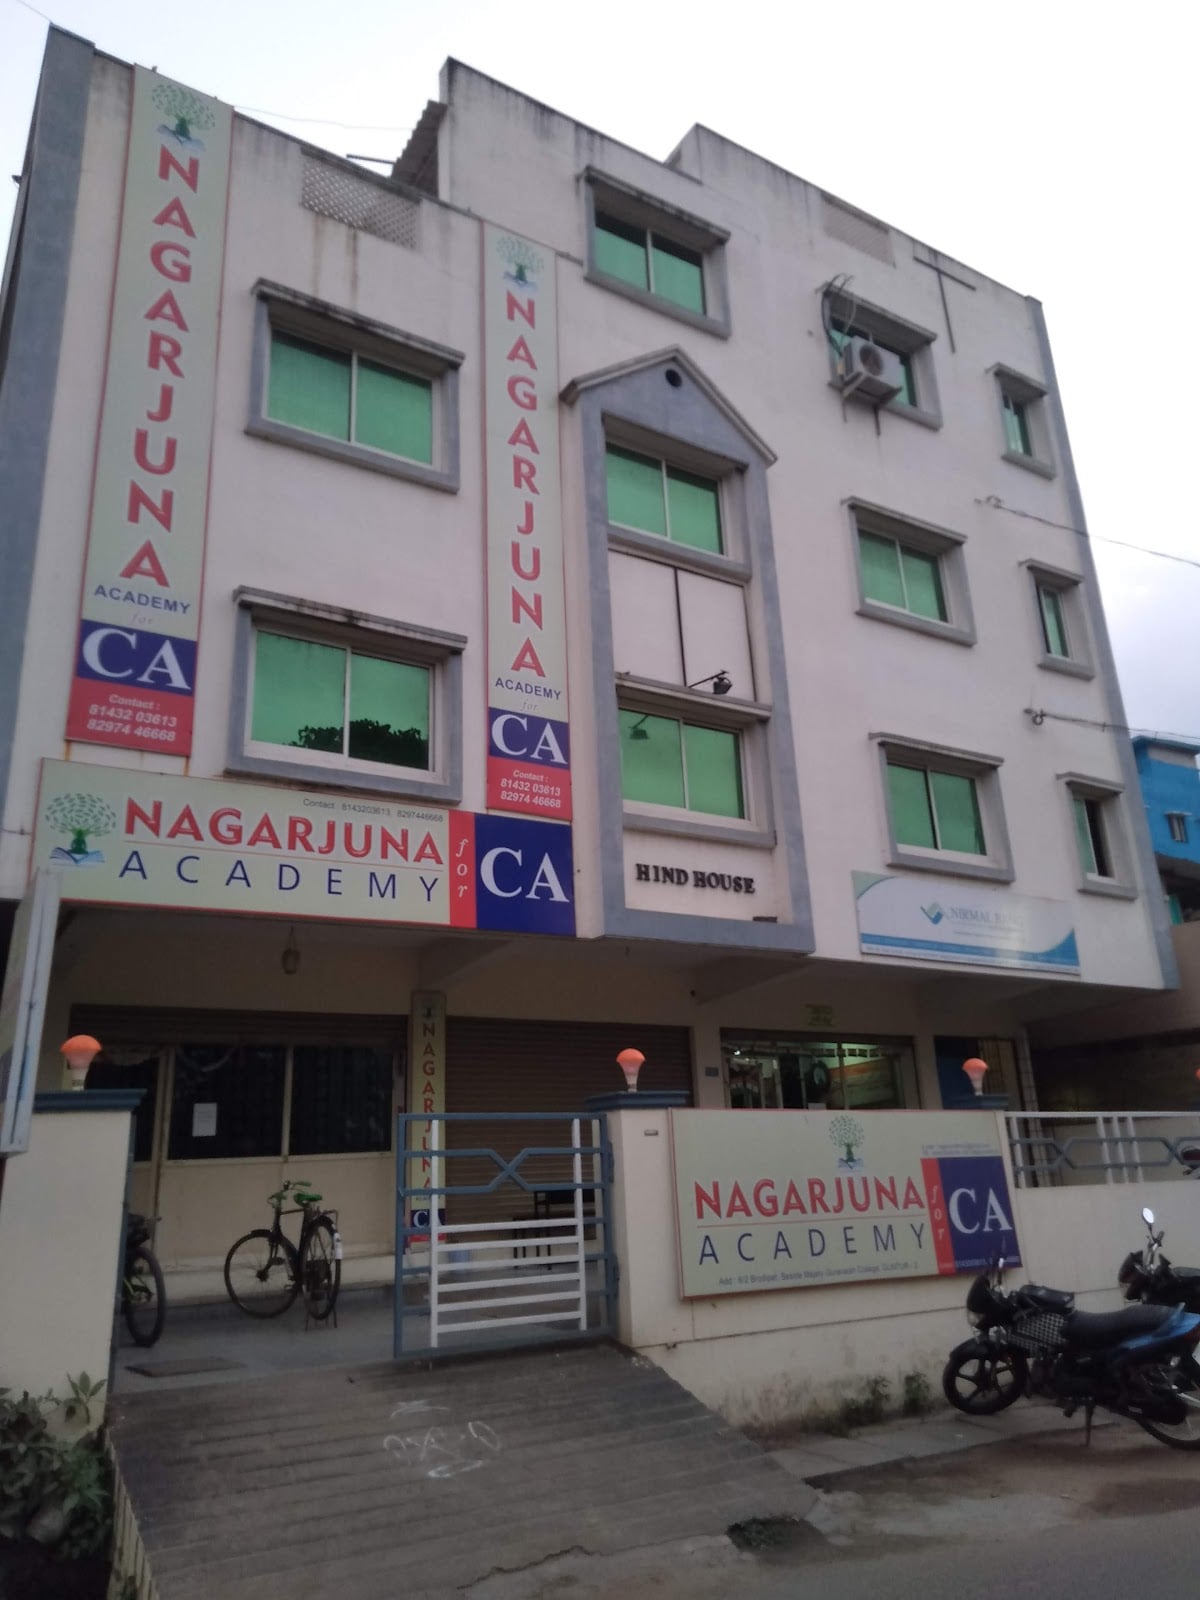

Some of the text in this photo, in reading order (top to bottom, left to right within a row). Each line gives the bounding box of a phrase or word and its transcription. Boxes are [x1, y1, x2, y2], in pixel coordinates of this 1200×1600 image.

[120, 144, 199, 588] NAGARJUNA
[506, 289, 546, 677] NAGARJUNA
[94, 584, 190, 614] ACADEMY
[82, 627, 192, 690] CA
[495, 677, 561, 701] ACADEMY
[520, 699, 538, 712] for
[491, 713, 568, 766] CA
[500, 777, 561, 797] 81432 03613
[501, 790, 530, 804] 82974
[513, 769, 545, 783] Contact
[125, 796, 444, 865] NAGARJUNA
[118, 850, 439, 902] ACADEMY
[455, 837, 469, 898] for
[480, 846, 570, 904] CA
[635, 863, 756, 894] HIND HOUSE
[694, 1176, 925, 1220] NAGARJUNA
[932, 1185, 945, 1241] for
[949, 1187, 1013, 1234] CA
[699, 1223, 925, 1266] ACADEMY
